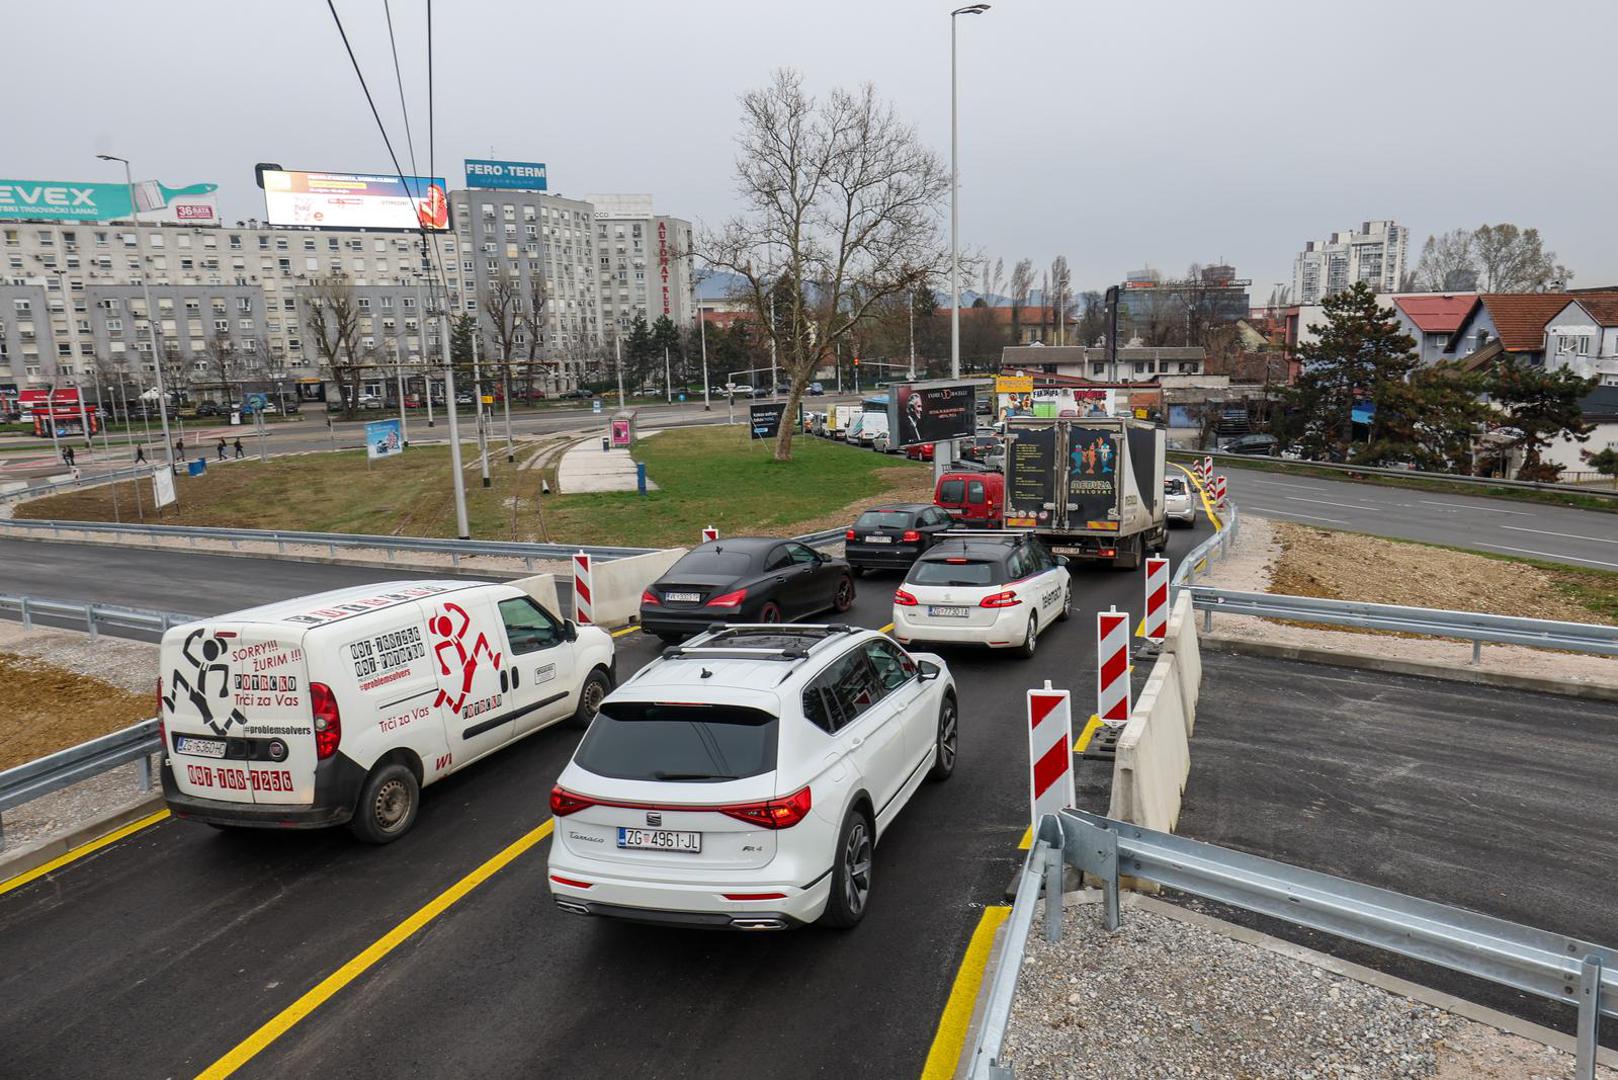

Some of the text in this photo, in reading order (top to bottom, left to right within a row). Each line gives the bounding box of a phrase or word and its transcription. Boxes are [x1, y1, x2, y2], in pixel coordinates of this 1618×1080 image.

[658, 222, 668, 283] AUTOMAT
[1041, 582, 1061, 610] telemach
[232, 639, 278, 662] SORRY!!!
[252, 653, 288, 672] ŽURIM
[359, 668, 411, 691] #problemsolvers
[234, 693, 299, 707] Trči za Vas
[243, 724, 312, 736] #problemsolvers
[379, 706, 430, 733] Trči za Vas
[626, 830, 642, 845] ZG
